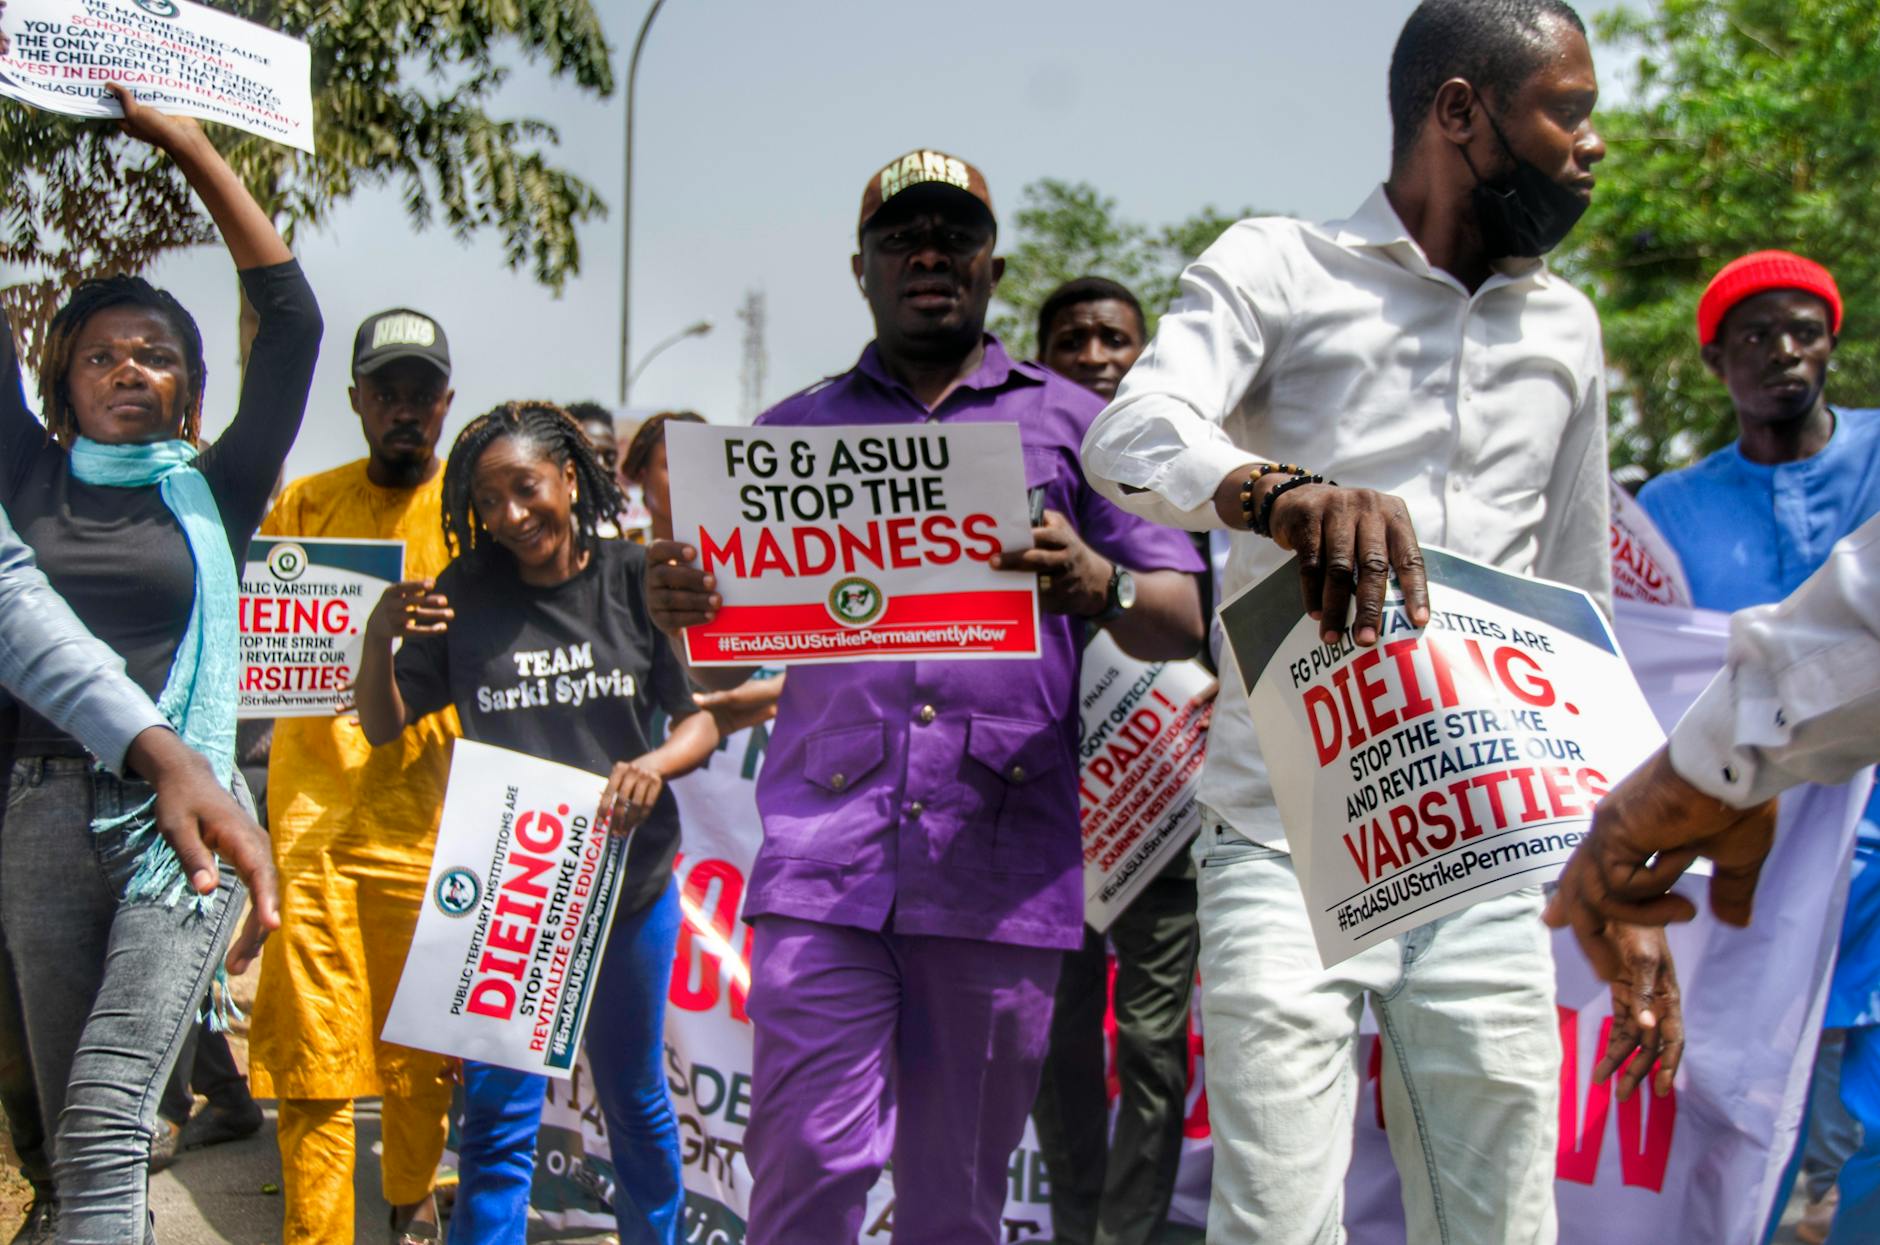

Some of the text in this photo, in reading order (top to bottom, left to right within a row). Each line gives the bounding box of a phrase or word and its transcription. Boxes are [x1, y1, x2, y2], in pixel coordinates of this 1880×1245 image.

[24, 20, 61, 34] YOU
[67, 26, 117, 43] CAN'T
[203, 63, 272, 94] DESTROY
[72, 15, 154, 42] SCHOOLS
[86, 7, 221, 57] YOUR CHILDREN
[115, 7, 195, 39] MADNESS
[200, 36, 271, 65] BECAUSE
[2, 56, 300, 128] NVEST IN EDUCATION REASONABLY
[15, 33, 282, 106] THE ONLY SYSTEM THAT SERVES
[18, 48, 275, 112] THE CHILDREN OF THE MASSES
[725, 437, 950, 479] FG & ASUU
[741, 477, 947, 523] STOP THE
[700, 514, 1002, 578] MADNESS
[240, 598, 357, 636] IEING.
[241, 582, 363, 597] BLIC VARSITIES ARE
[240, 636, 334, 650] TOP THE STRIKE
[247, 651, 316, 664] REVITALIZE
[320, 652, 345, 664] OUR
[513, 641, 594, 677] TEAM
[718, 624, 1006, 653] #EndASUUStrikePermanentlyNow
[1290, 609, 1555, 689] FG PUBLI ASITIES ARE
[239, 666, 351, 691] RSITIES
[477, 668, 635, 713] Sarki Sylvia
[1110, 660, 1166, 723] OFFICIAL
[1302, 638, 1582, 768] DIEING.
[1088, 709, 1162, 788] PAID
[1347, 737, 1586, 823] AND REVITALIZE OUR
[1350, 739, 1392, 782] STOP
[1393, 719, 1440, 758] THE
[1098, 819, 1144, 873] JOURNEY
[1343, 766, 1611, 885] VARSITIES
[450, 784, 519, 1016] PUBLIC TERTIARY INSTITUTIONS ARE
[467, 803, 570, 1021] DIEING.
[520, 815, 588, 1017] STOP THE STRIKE AND
[529, 945, 571, 1052] REVITALIZE
[562, 900, 583, 942] OUR
